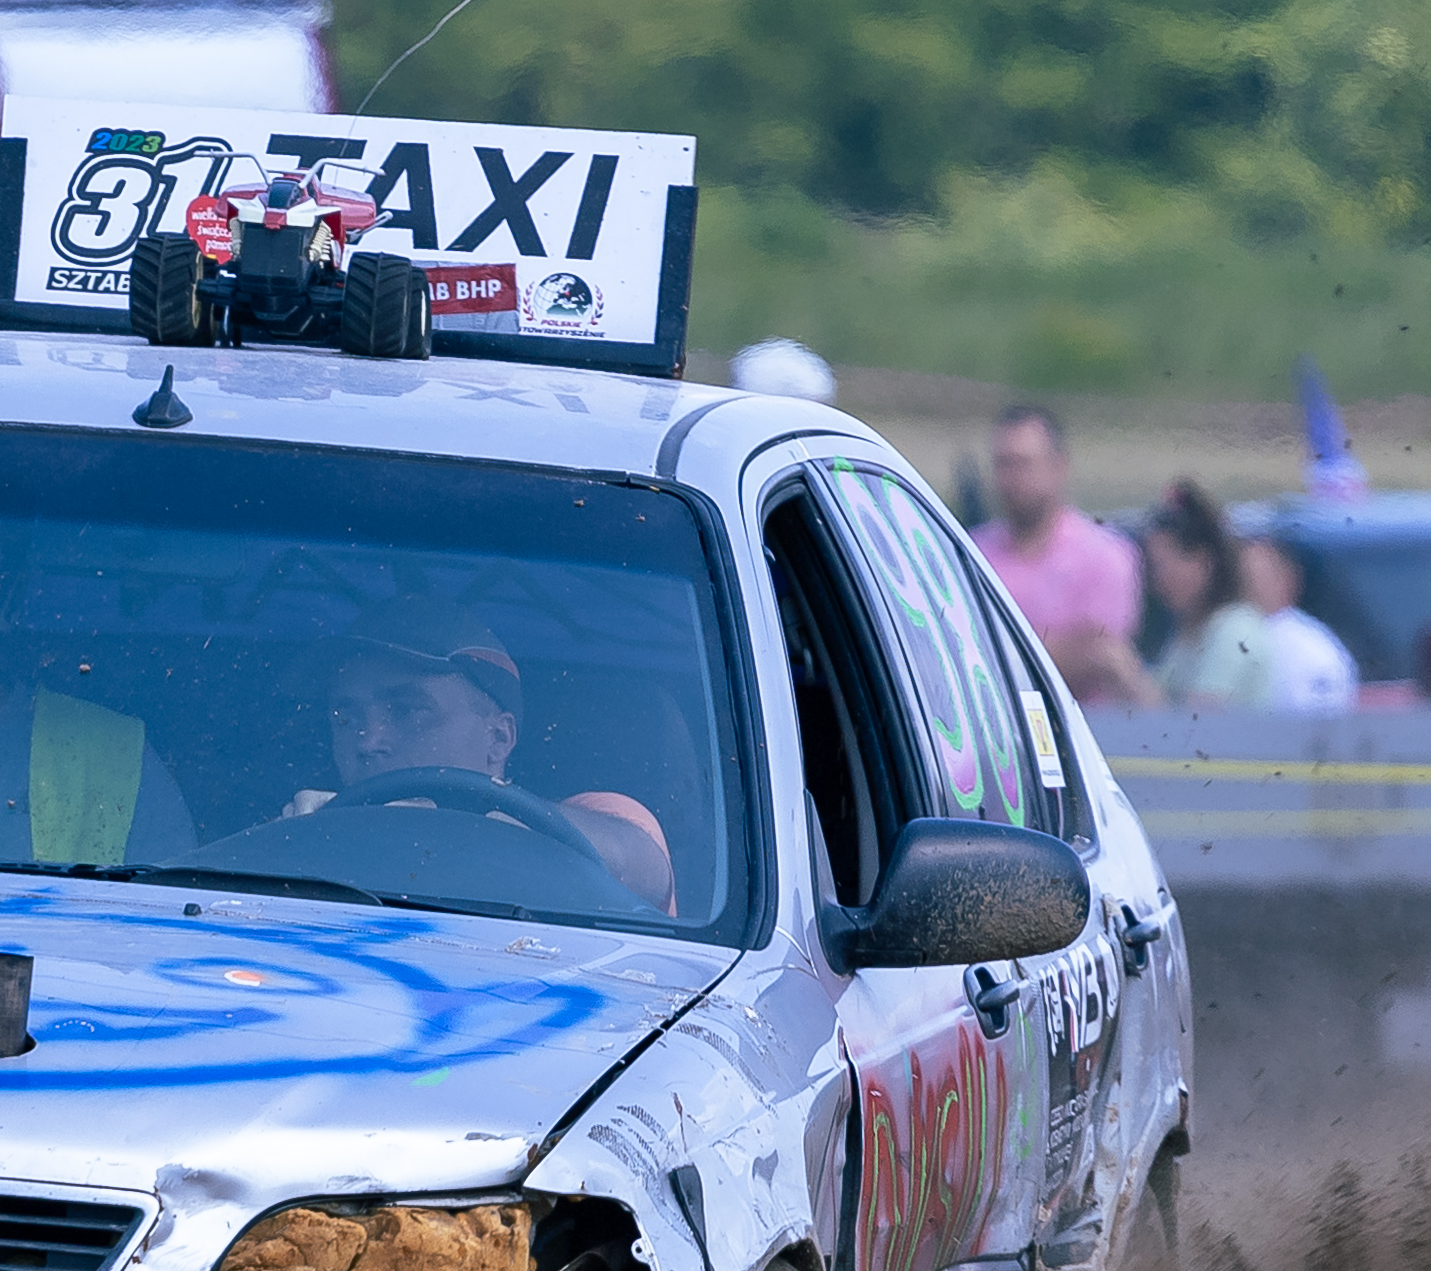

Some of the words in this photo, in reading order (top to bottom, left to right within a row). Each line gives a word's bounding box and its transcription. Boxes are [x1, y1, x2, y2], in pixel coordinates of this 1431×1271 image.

[91, 131, 162, 154] 2023
[51, 136, 233, 269] 31
[266, 132, 621, 261] TAXI
[456, 278, 502, 300] BHP
